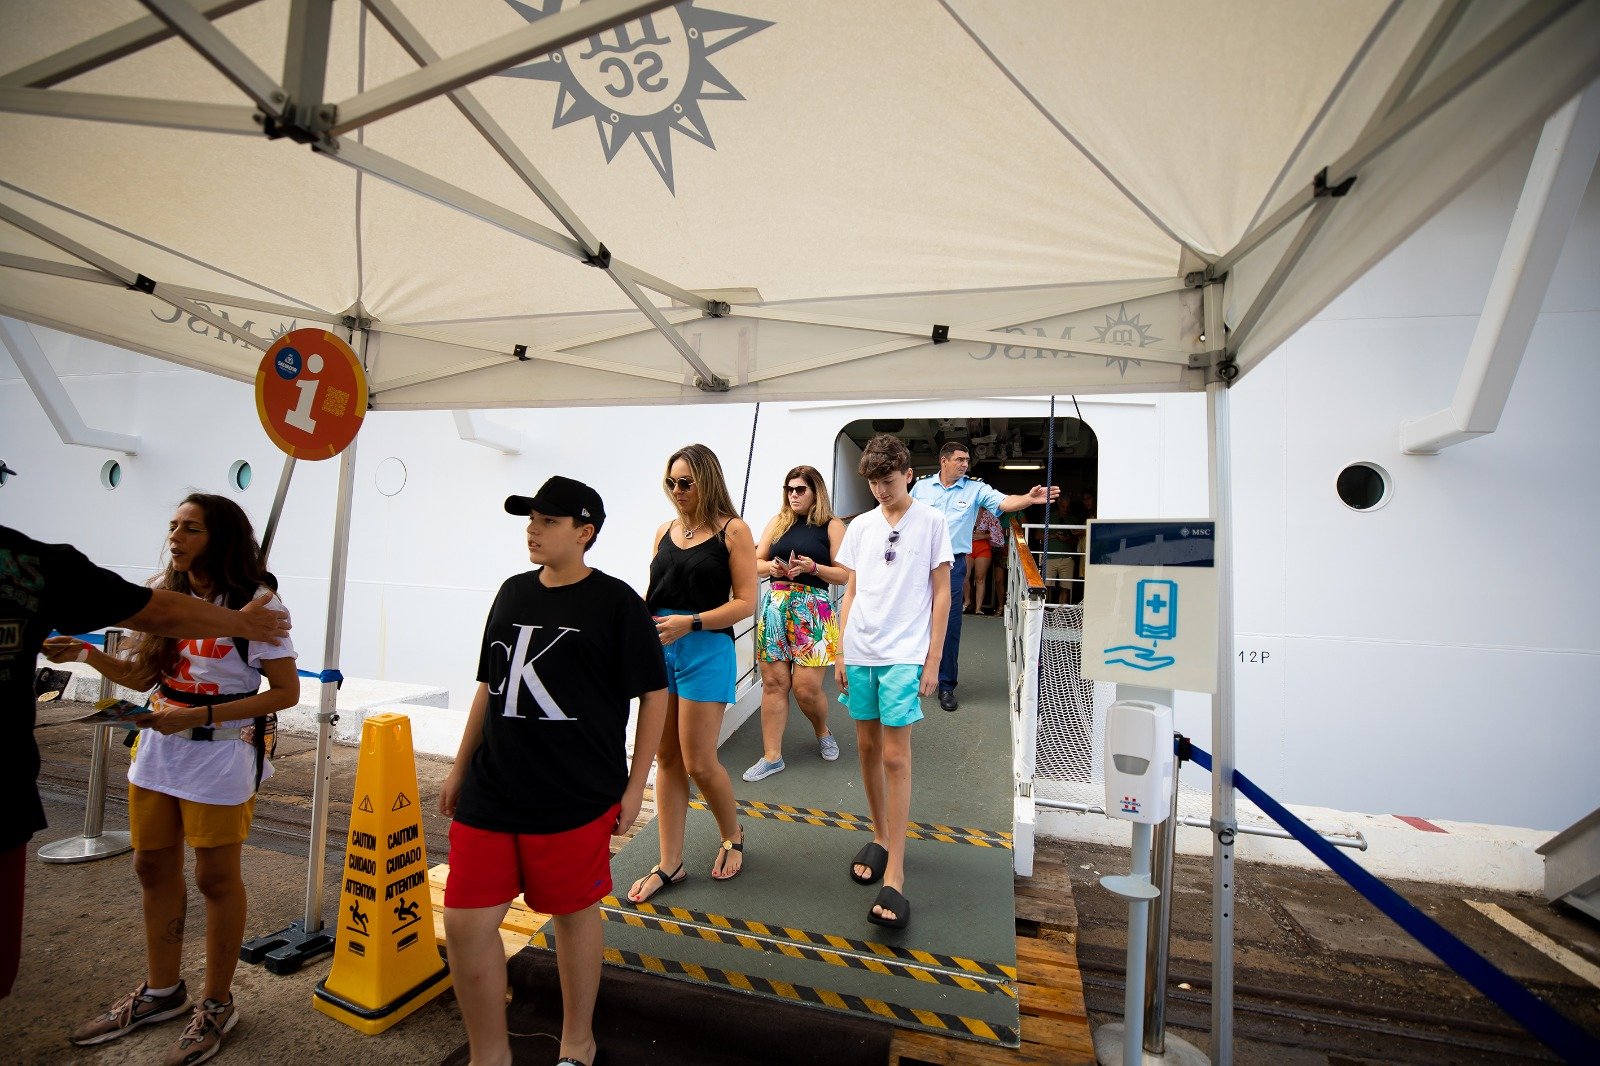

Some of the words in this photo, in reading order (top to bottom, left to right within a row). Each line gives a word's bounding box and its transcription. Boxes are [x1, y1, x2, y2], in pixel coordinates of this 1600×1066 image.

[1192, 528, 1211, 536] MSC
[1238, 650, 1271, 664] 12P
[488, 623, 581, 721] CK
[352, 829, 376, 851] CAUTION
[387, 823, 419, 850] CAUTION
[348, 853, 376, 876] CUIDADO
[386, 846, 422, 875] CUIDADO
[345, 878, 377, 903] ATTENTION
[385, 869, 425, 902] ATTENTION
